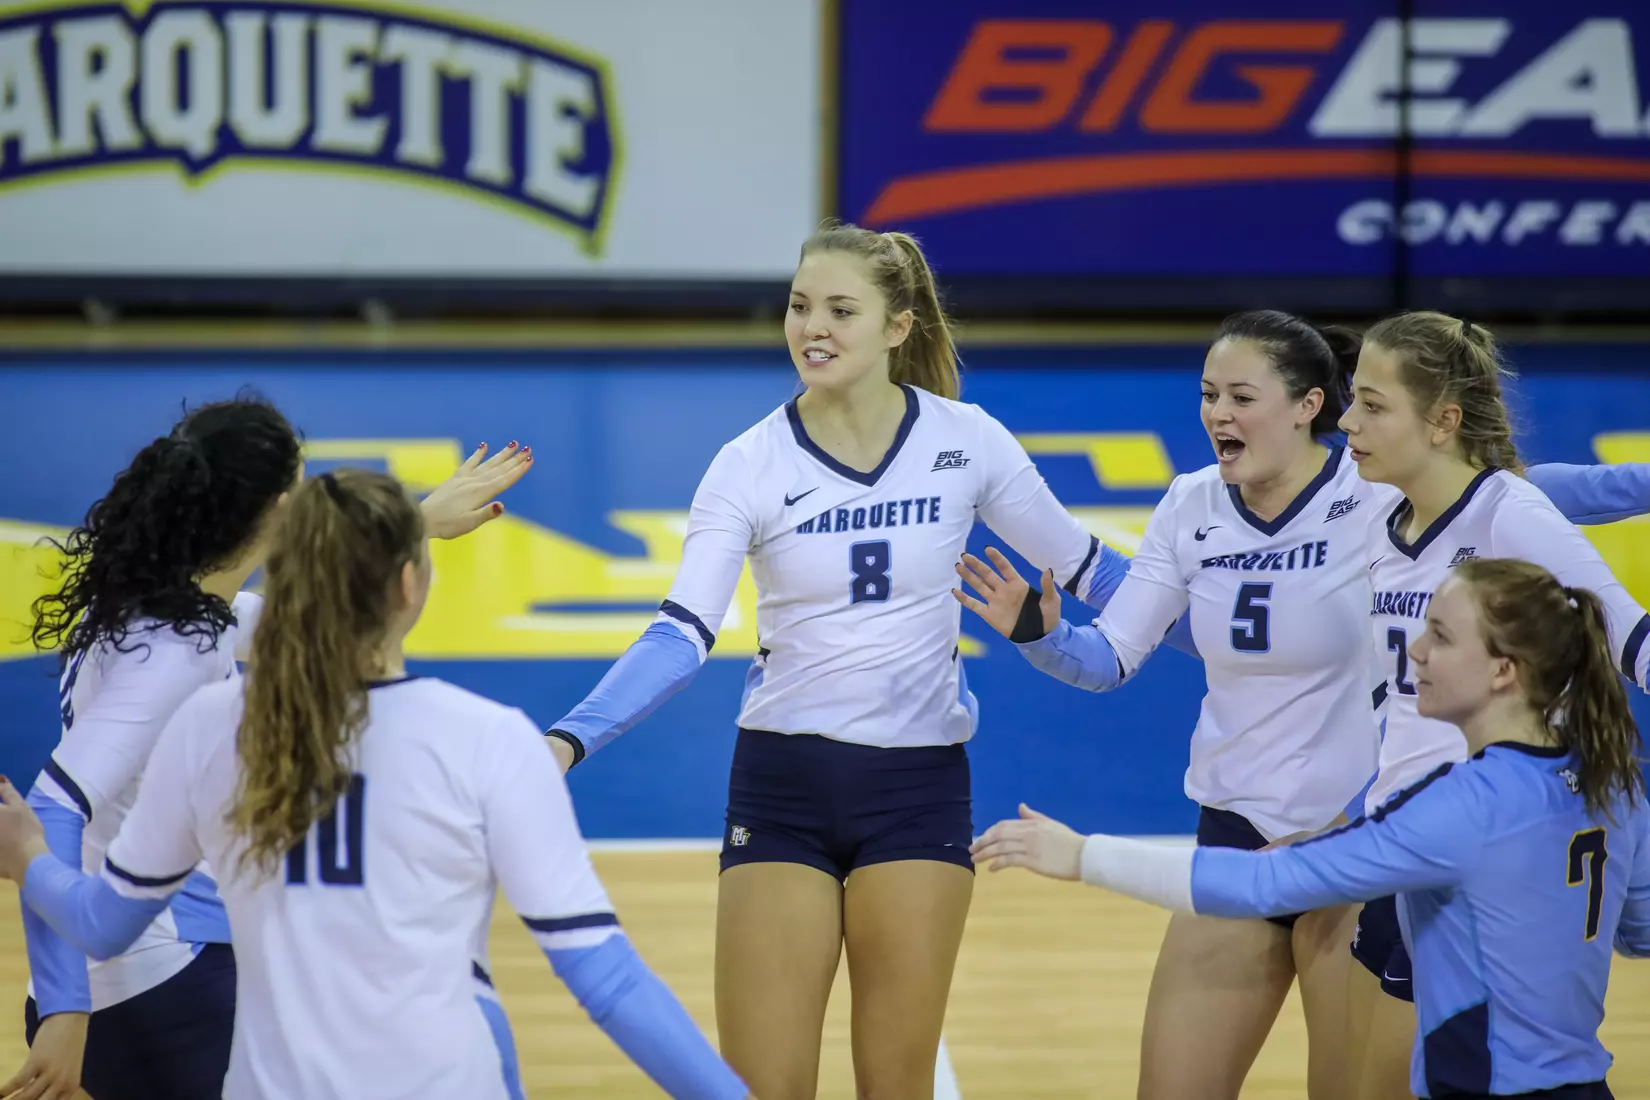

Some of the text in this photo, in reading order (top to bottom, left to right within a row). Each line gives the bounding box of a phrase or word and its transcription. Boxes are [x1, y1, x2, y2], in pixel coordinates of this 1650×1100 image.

[1309, 18, 1650, 138] EA
[933, 458, 971, 468] EAST
[937, 450, 964, 460] BIG
[1326, 500, 1361, 519] EAST
[1330, 495, 1354, 510] BIG
[796, 496, 942, 535] MARQUETTE
[1450, 555, 1481, 565] EA
[1456, 547, 1476, 556] BIG
[849, 539, 892, 605] 8
[1230, 581, 1274, 654] 5
[1566, 826, 1608, 942] 7
